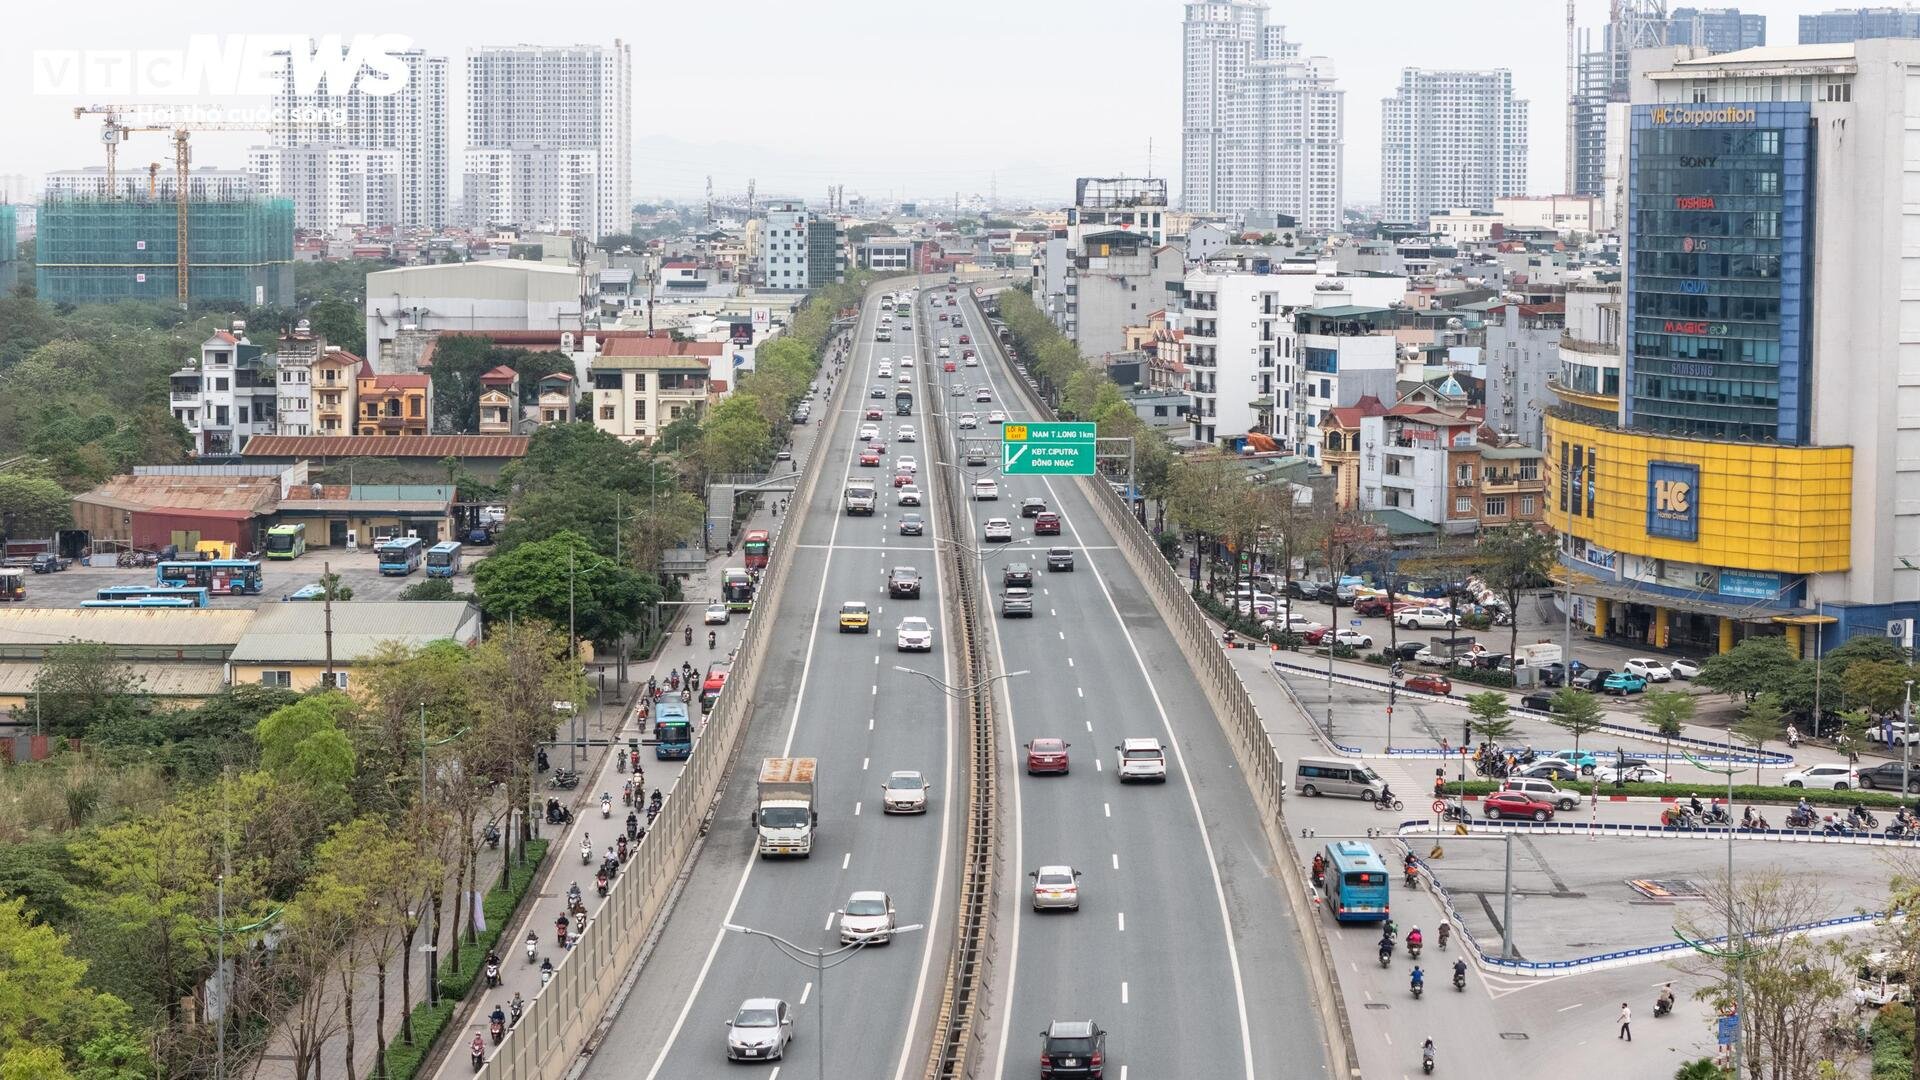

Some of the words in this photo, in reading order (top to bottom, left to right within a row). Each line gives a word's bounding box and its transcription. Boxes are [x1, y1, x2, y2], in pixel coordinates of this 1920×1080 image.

[1650, 107, 1672, 124] VHC
[1674, 106, 1756, 127] Corporation
[1680, 155, 1719, 168] SONY
[1676, 197, 1715, 209] TOSHIBA
[1680, 280, 1708, 293] AQUA
[1664, 321, 1709, 334] MAGIC
[1671, 363, 1713, 376] SAMSUNG
